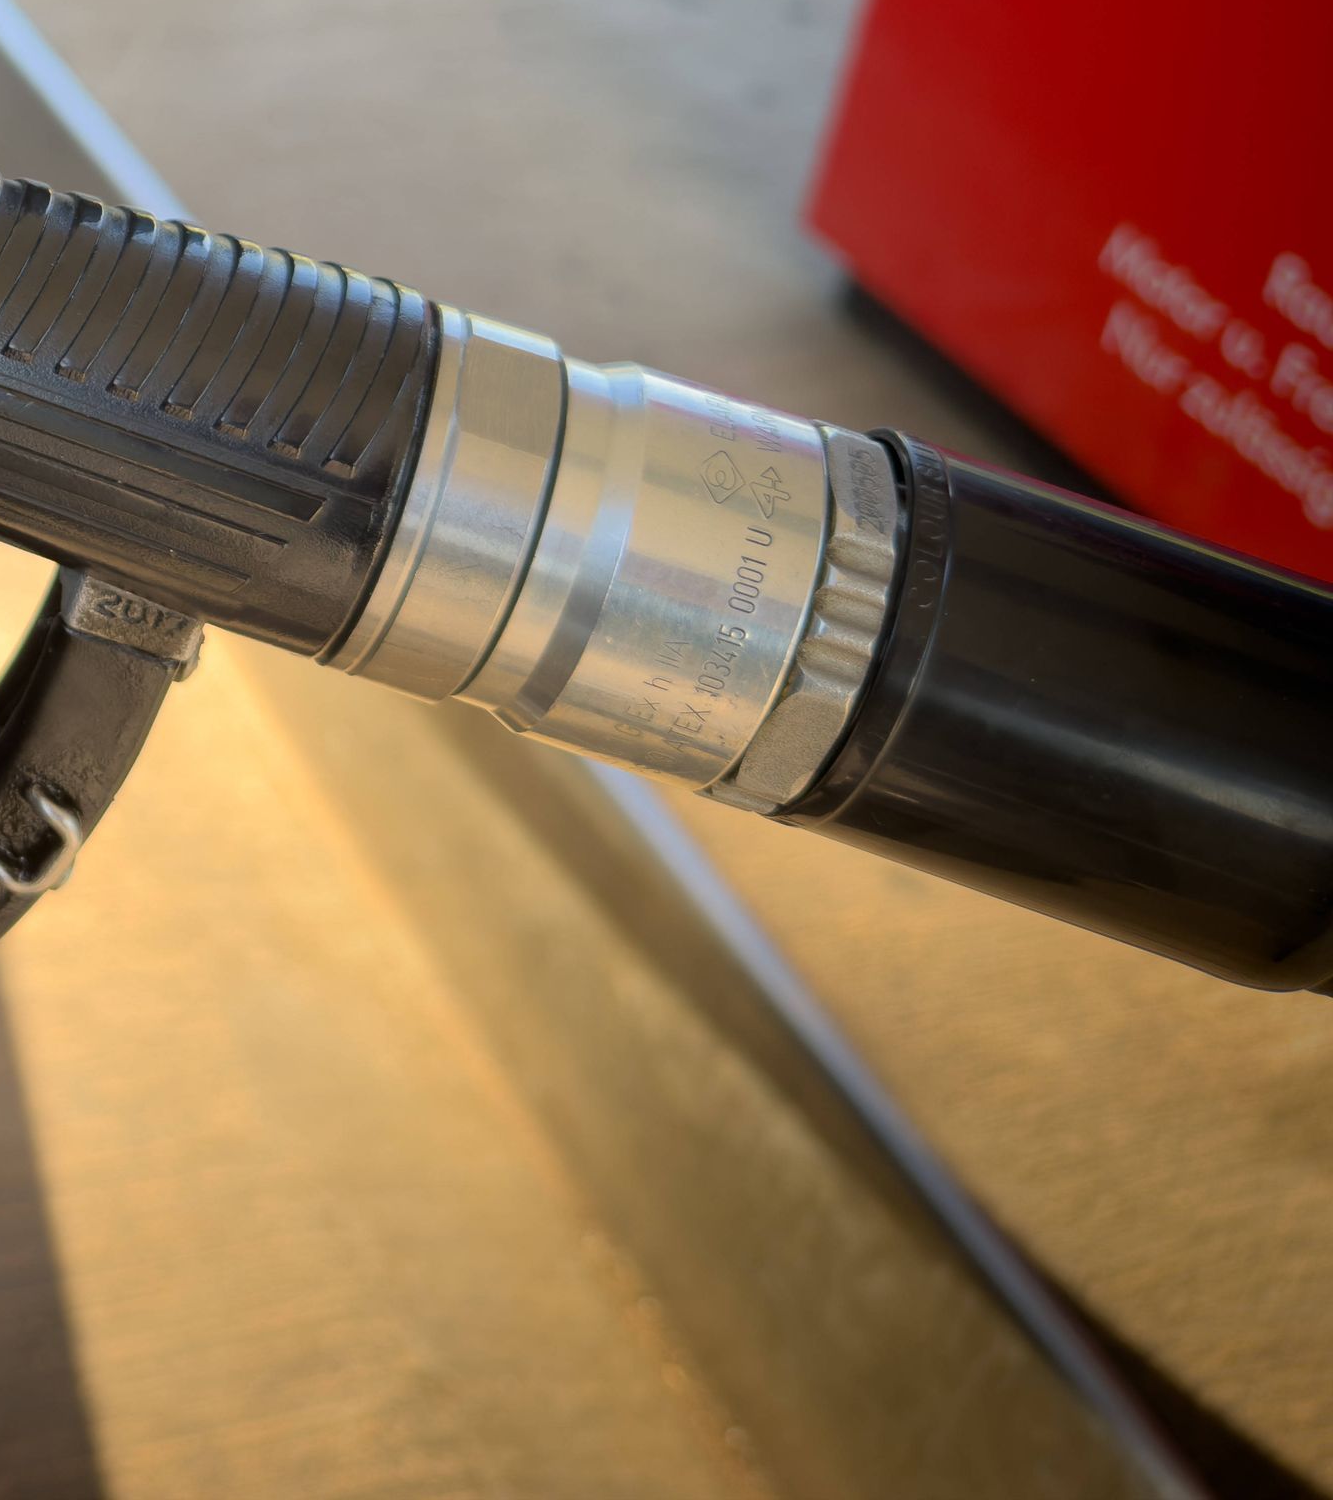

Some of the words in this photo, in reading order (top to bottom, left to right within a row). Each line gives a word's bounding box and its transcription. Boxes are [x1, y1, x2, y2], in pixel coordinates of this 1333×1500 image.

[745, 526, 774, 547] U
[727, 555, 768, 614] 0001
[693, 624, 748, 698] 103415
[663, 703, 711, 753] ATEX
